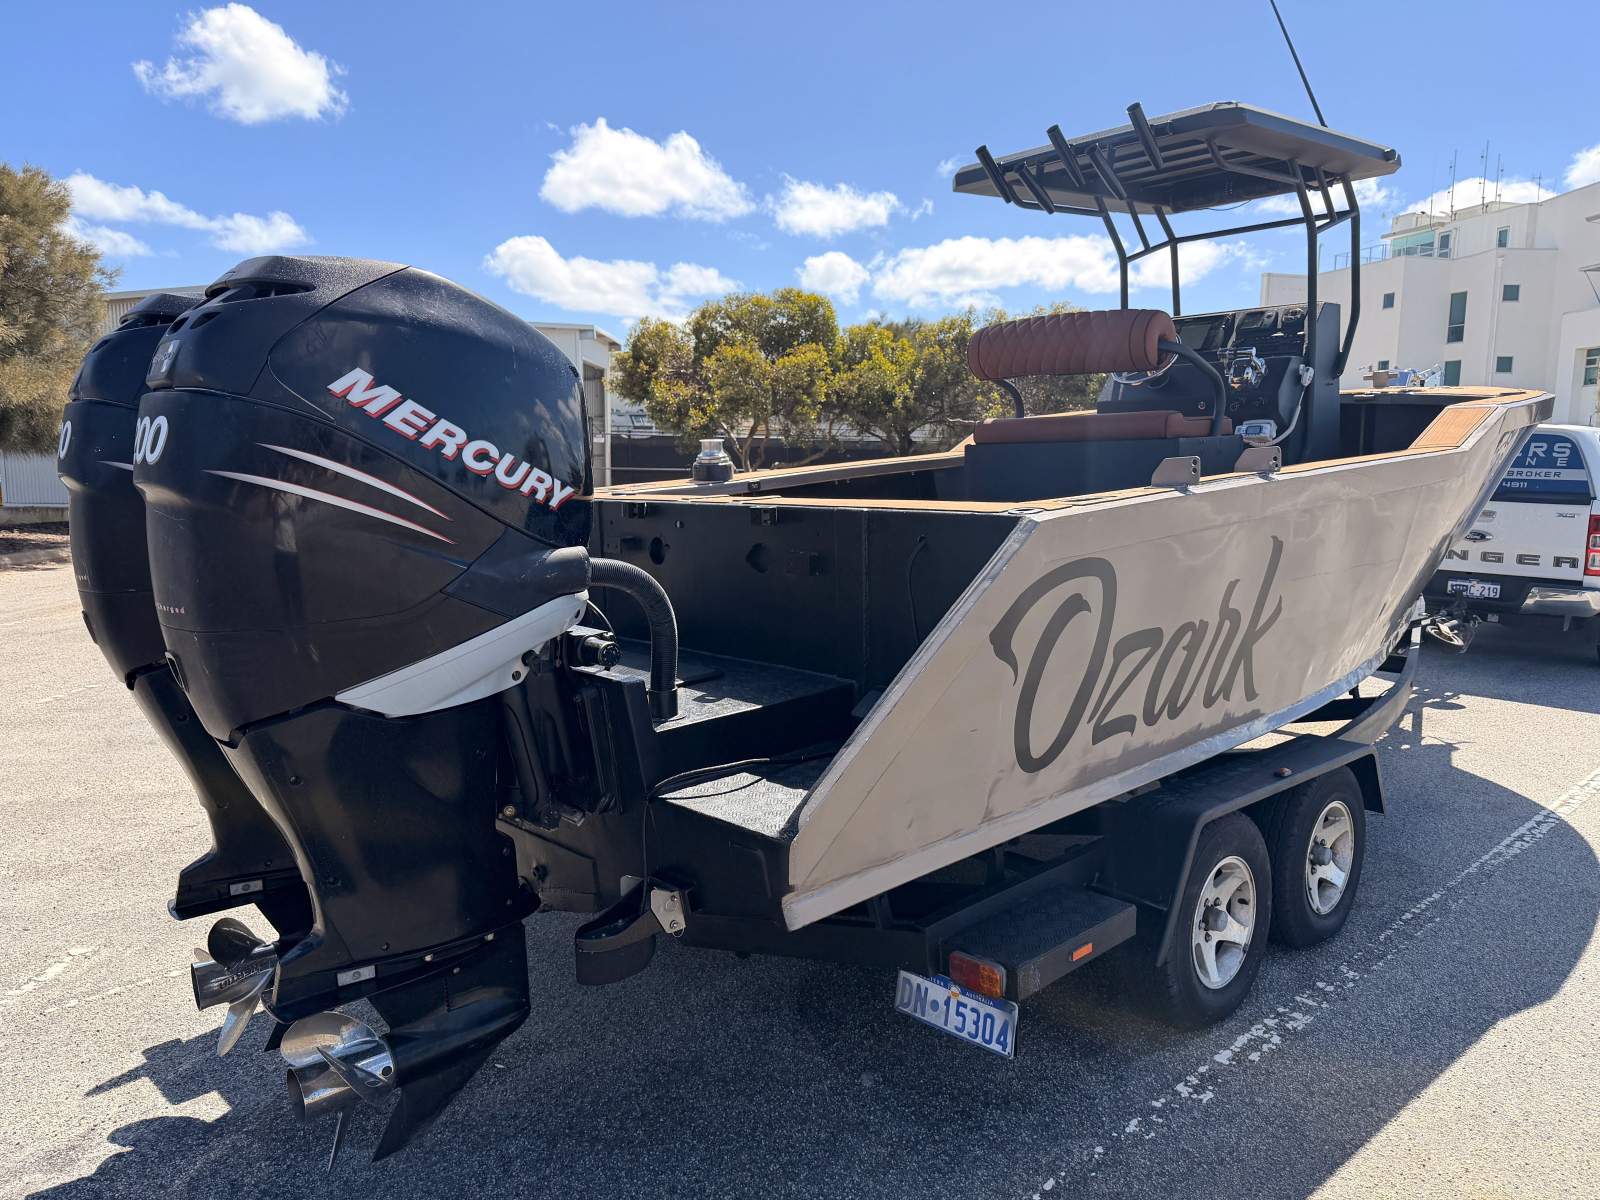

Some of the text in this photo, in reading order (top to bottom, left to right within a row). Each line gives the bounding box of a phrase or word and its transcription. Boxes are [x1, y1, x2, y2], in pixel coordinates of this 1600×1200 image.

[326, 367, 576, 512] MERCURY
[1506, 470, 1562, 478] BROKER
[1516, 442, 1573, 458] RS
[988, 535, 1284, 774] Ozark
